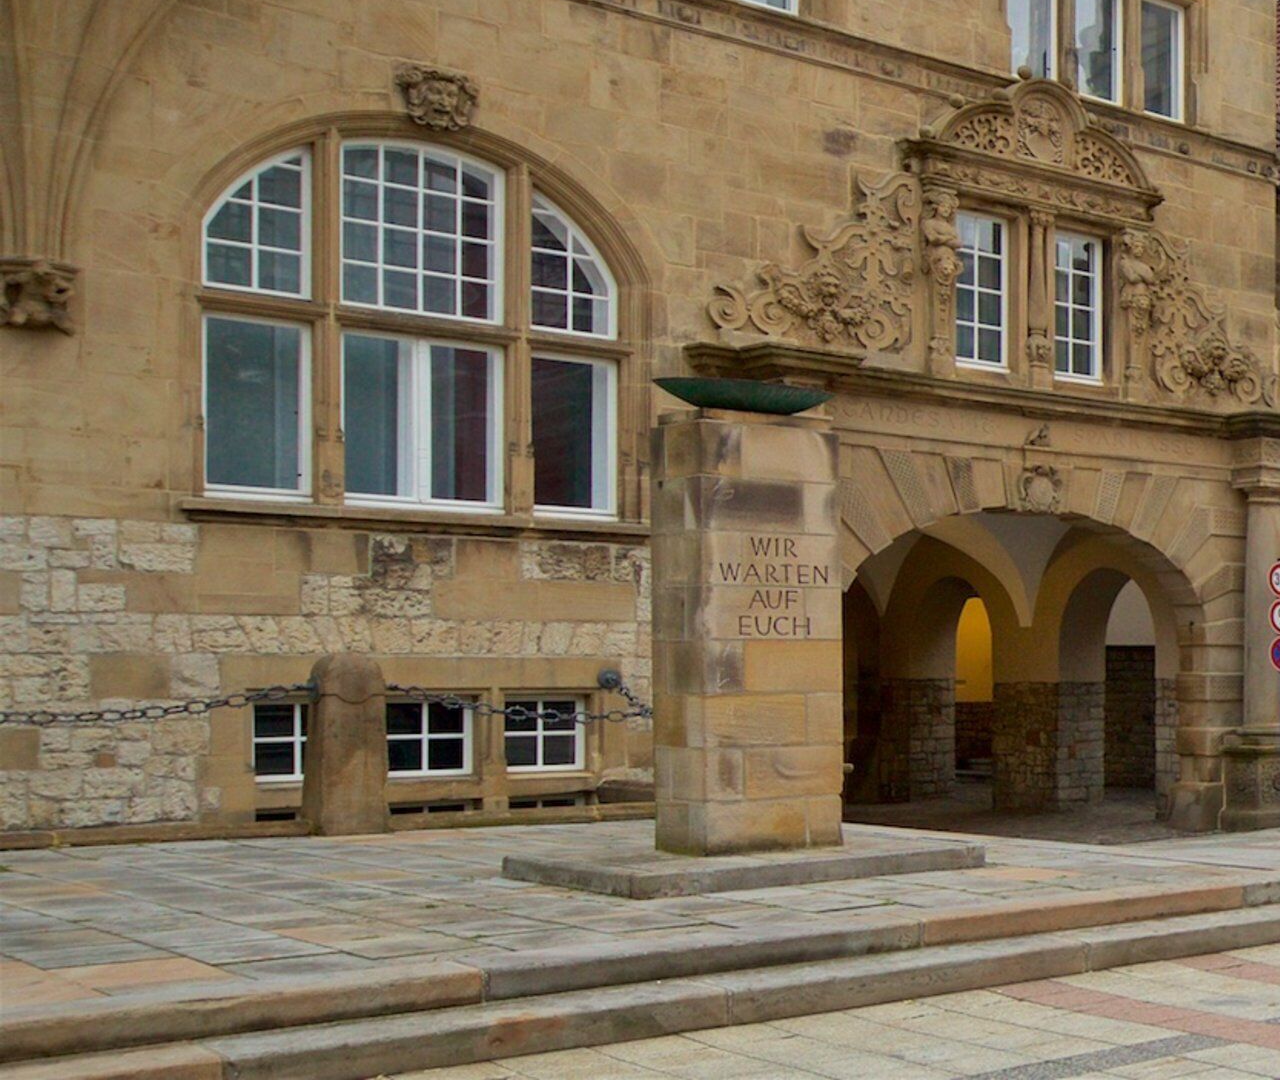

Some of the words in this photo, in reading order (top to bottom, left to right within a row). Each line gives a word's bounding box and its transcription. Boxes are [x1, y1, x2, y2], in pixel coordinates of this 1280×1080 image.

[750, 536, 798, 558] WIR
[719, 562, 829, 585] WARTEN
[748, 589, 798, 610] AUF
[738, 615, 811, 636] EUCH
